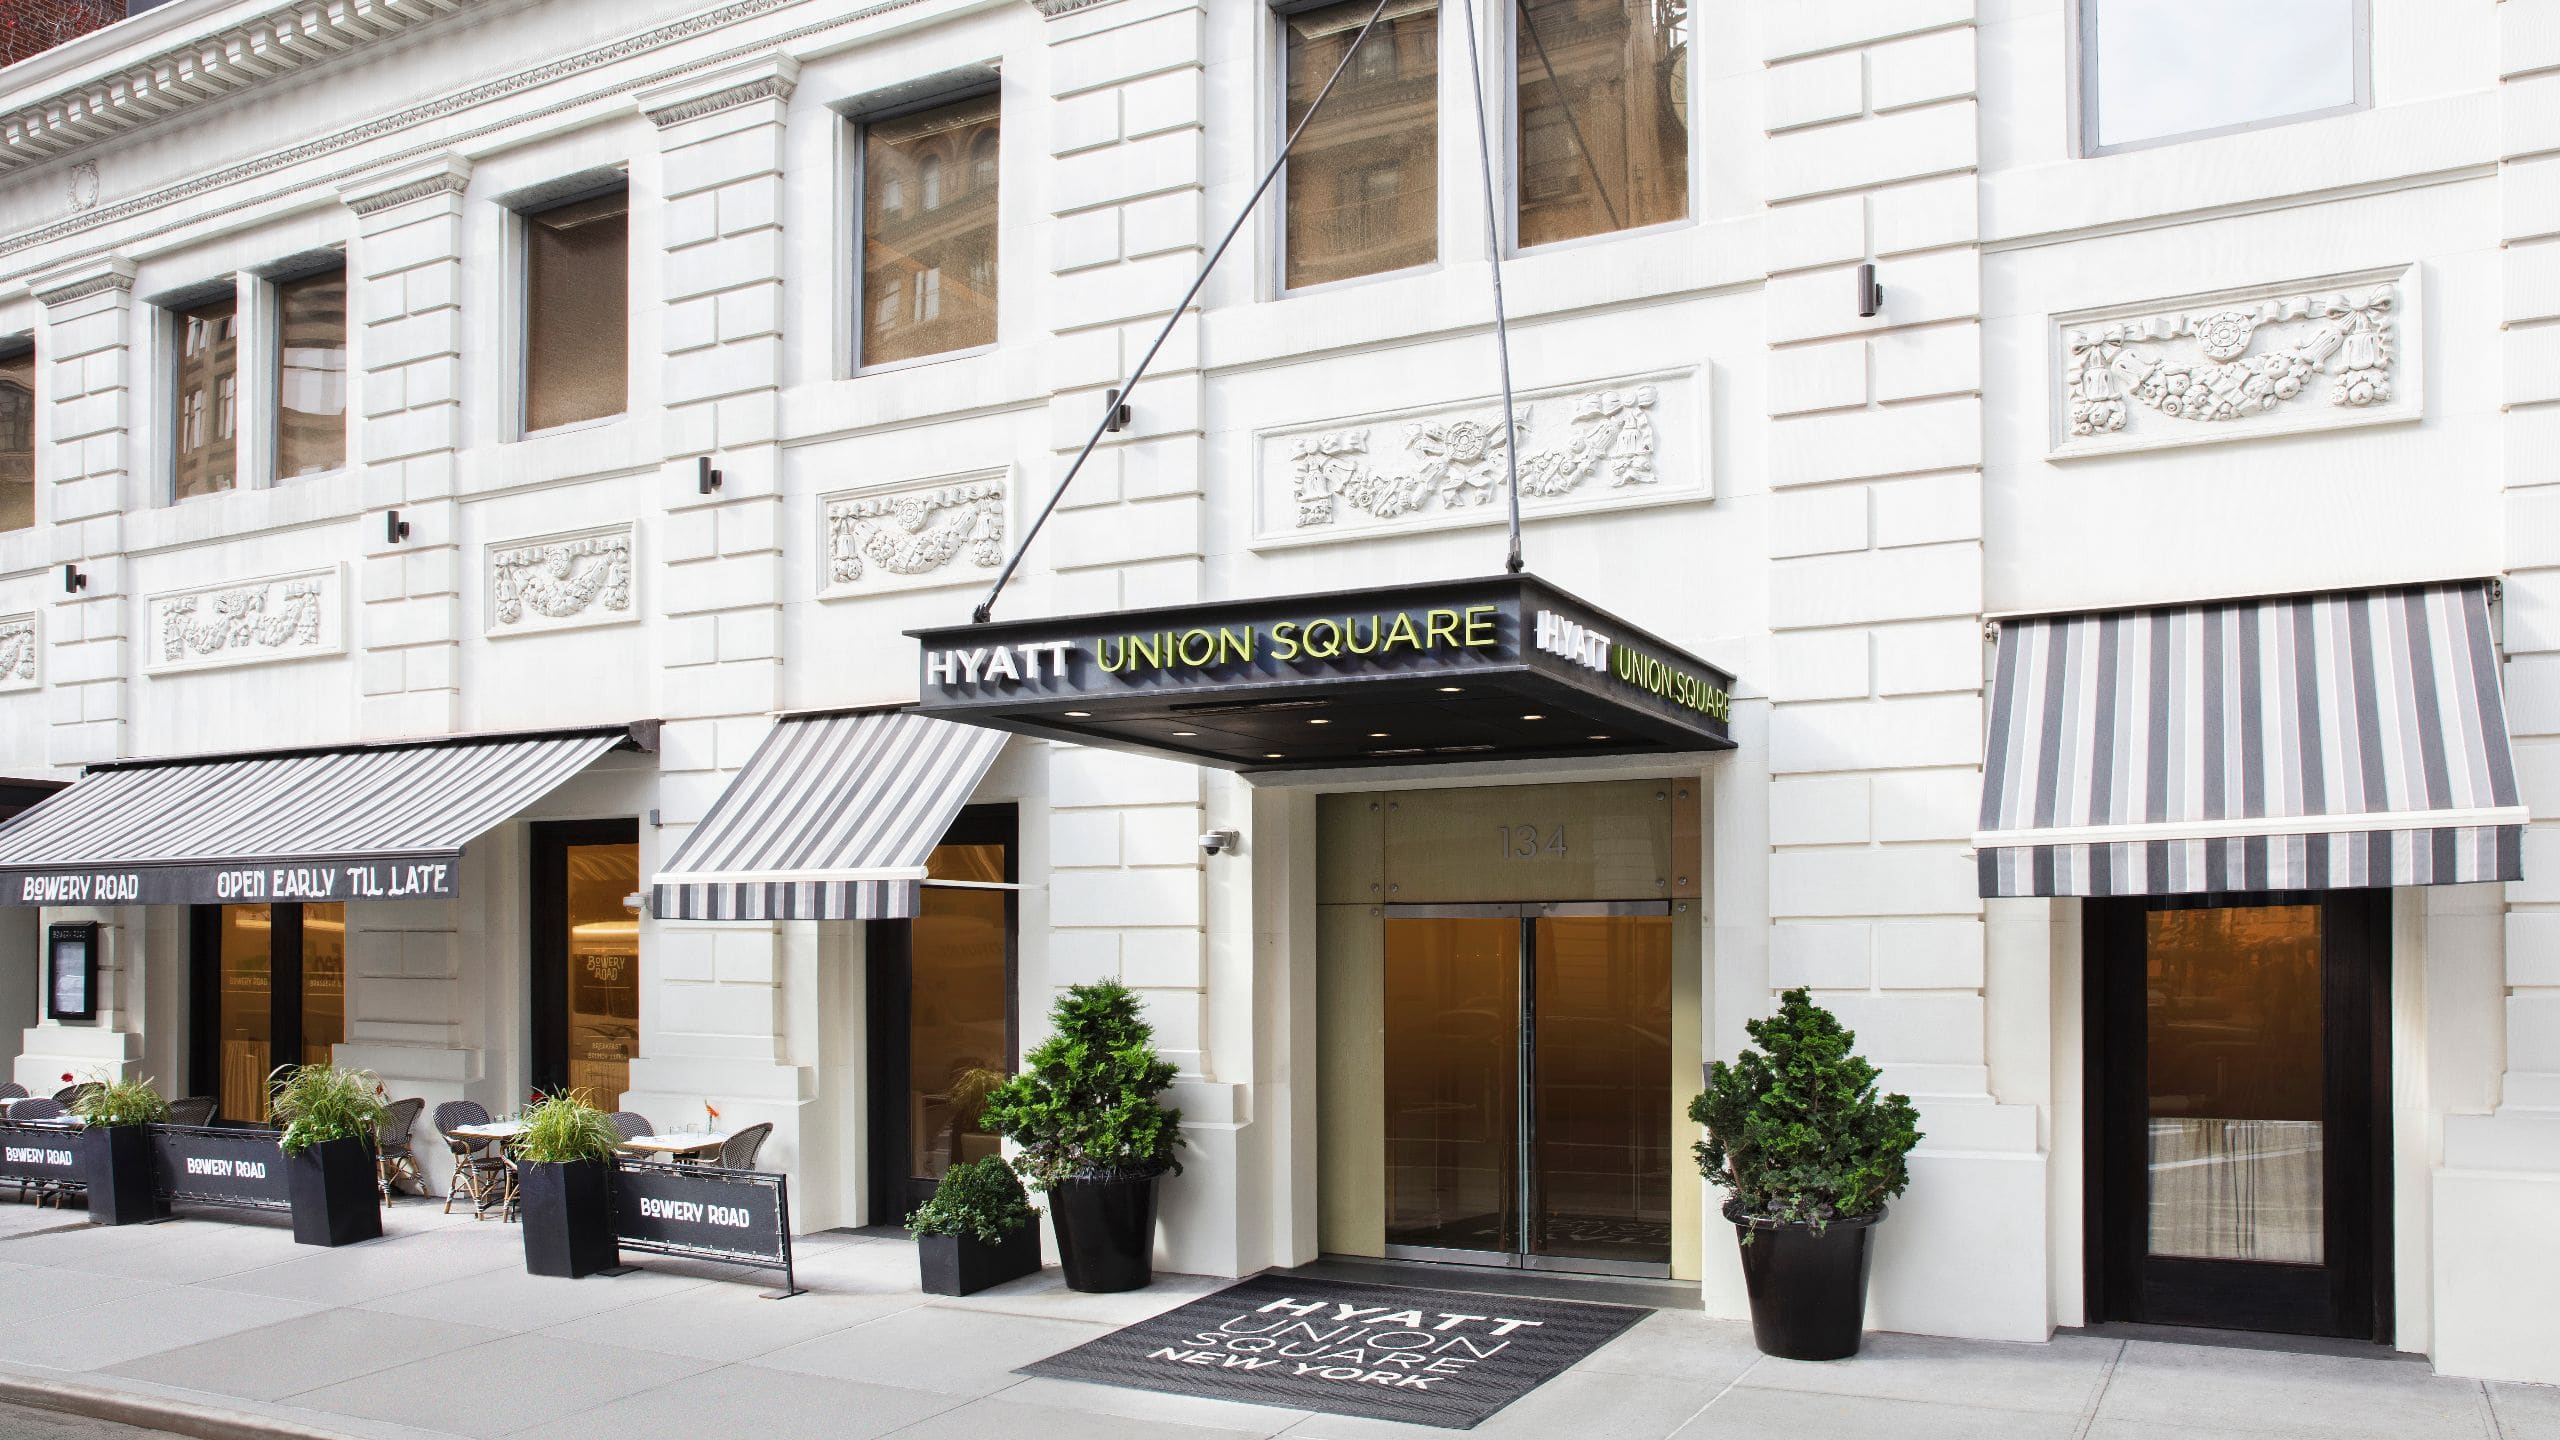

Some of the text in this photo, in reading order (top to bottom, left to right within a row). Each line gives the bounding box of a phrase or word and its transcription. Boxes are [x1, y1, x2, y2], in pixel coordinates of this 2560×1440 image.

[927, 605, 1498, 686] HYATT UNION SQUARE
[1535, 609, 1730, 724] HYATT UNION SQUARE
[1498, 824, 1568, 861] 134
[22, 874, 139, 901] BOWERY ROAD
[217, 864, 449, 898] OPEN EARLY TIL LATE
[587, 955, 625, 971] BOWERY
[594, 967, 618, 981] ROAD
[6, 1146, 72, 1166] BOWERY ROAD
[187, 1157, 266, 1179] BOWERY ROAD
[641, 1197, 750, 1228] BOWERY ROAD
[1255, 1297, 1544, 1337] HYATT
[1181, 1331, 1478, 1375] SQUARE
[1219, 1314, 1512, 1360] UNION
[1146, 1346, 1445, 1391] NEW YORK
